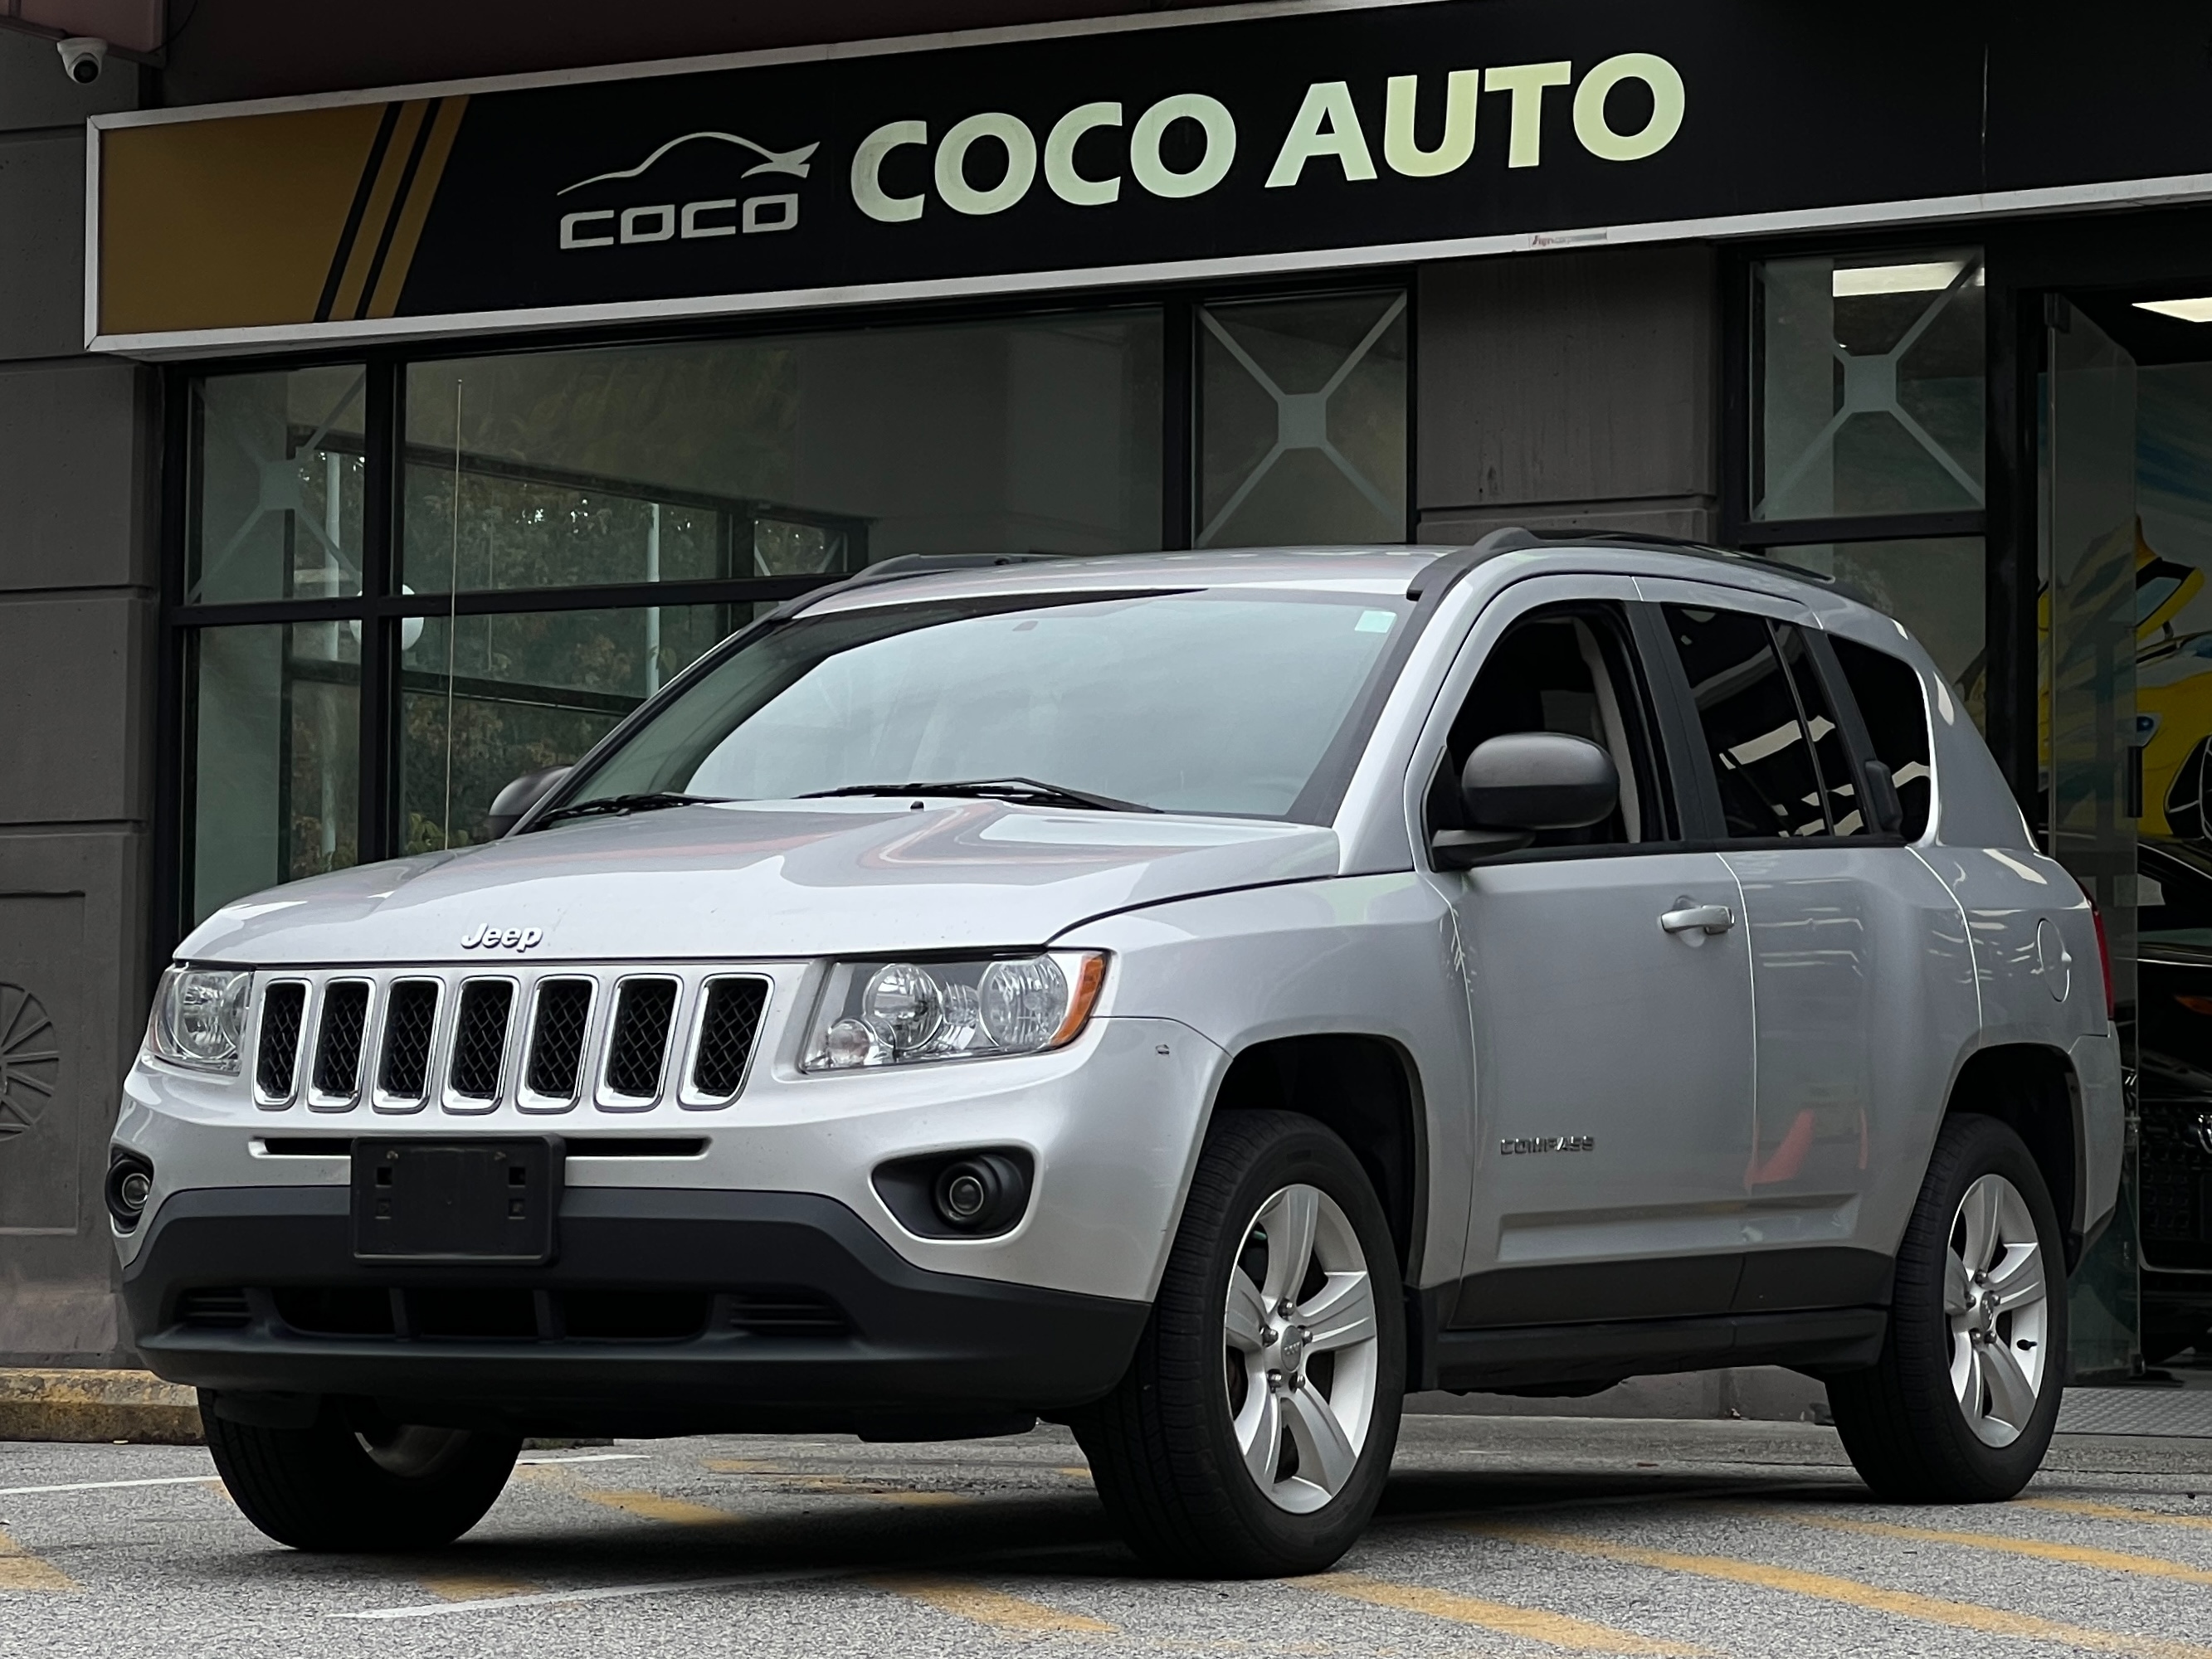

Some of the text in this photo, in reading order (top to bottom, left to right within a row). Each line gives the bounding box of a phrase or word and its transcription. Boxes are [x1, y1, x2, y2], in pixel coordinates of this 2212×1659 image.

[850, 52, 1685, 222] COCO AUTO
[560, 193, 798, 249] COCO
[460, 922, 543, 953] Jeep
[1500, 1135, 1594, 1155] COMPASS
